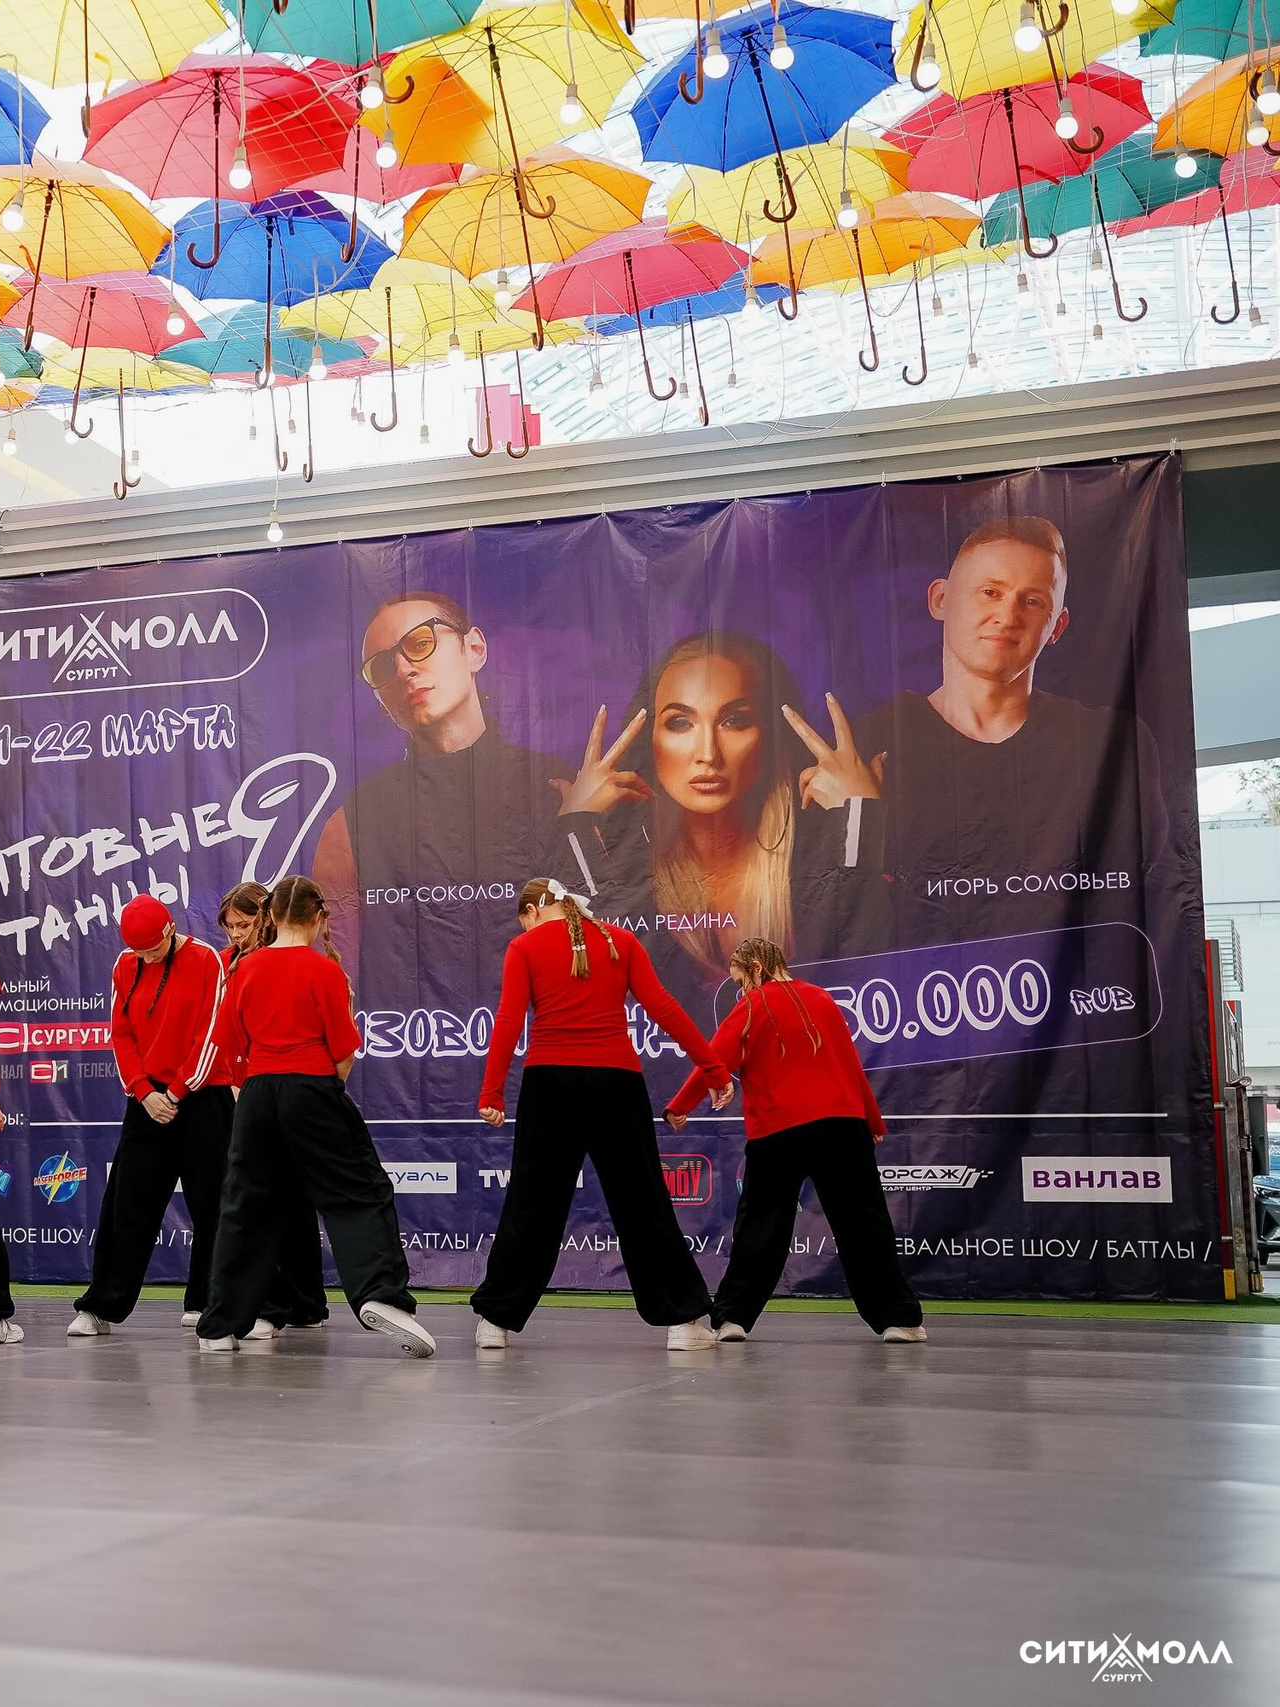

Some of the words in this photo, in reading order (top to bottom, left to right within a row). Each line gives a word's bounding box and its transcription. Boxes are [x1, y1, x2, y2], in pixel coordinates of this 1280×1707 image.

[111, 610, 238, 651] МОЛЛ
[66, 666, 118, 682] СУРГУТ
[101, 703, 236, 759] МАРТА
[365, 887, 411, 905] ЕГОР
[415, 882, 516, 903] СОКОЛОВ
[927, 877, 999, 897] ИГОРЬ
[1005, 871, 1131, 894] СОЛОВЬЕВ
[596, 914, 649, 932] ИЛА
[654, 912, 737, 932] РЕДИНА
[1070, 985, 1136, 1016] RUB
[31, 1027, 111, 1046] СУРГУТИ
[386, 1171, 449, 1185] уаль
[881, 1168, 961, 1180] ОРСАЖ
[1032, 1169, 1163, 1189] ванлав
[41, 1228, 84, 1245] ШОУ
[895, 1237, 1014, 1257] ЕВАЛЬНОЕ
[1022, 1239, 1081, 1259] ШОУ
[1106, 1240, 1195, 1260] БАТТЛЫ
